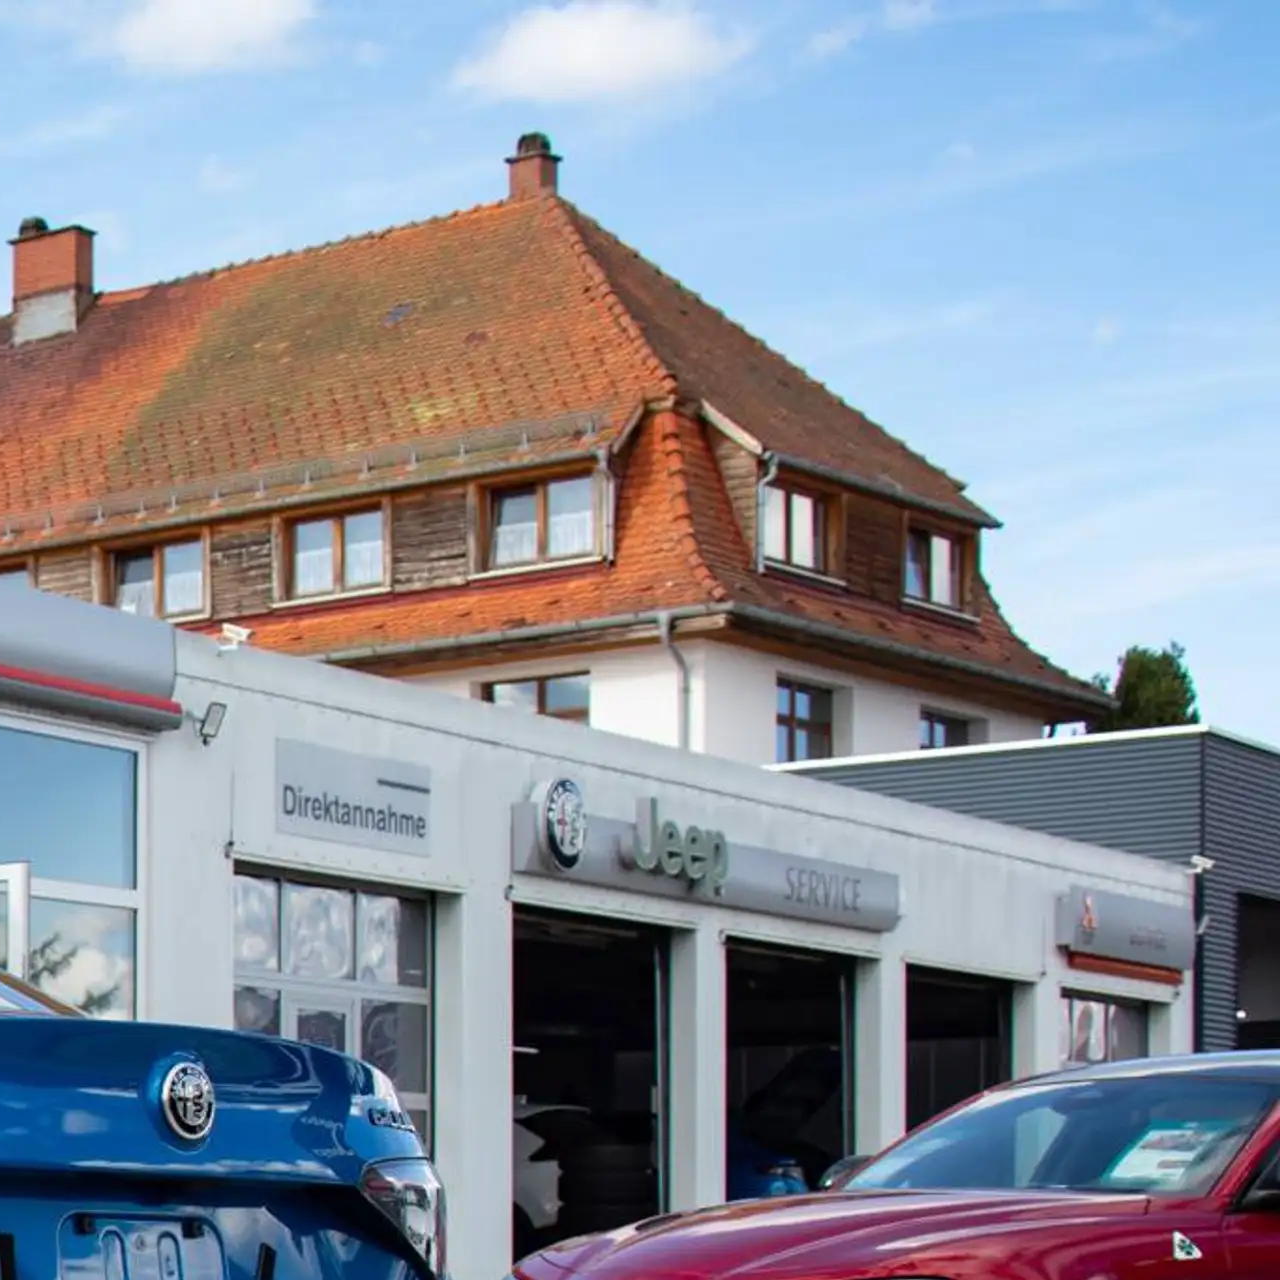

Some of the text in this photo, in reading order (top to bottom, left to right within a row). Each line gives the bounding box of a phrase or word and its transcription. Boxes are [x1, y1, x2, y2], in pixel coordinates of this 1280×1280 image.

[282, 784, 426, 838] Direktannahme
[633, 796, 728, 898] Jeep
[785, 867, 861, 912] SERVICE
